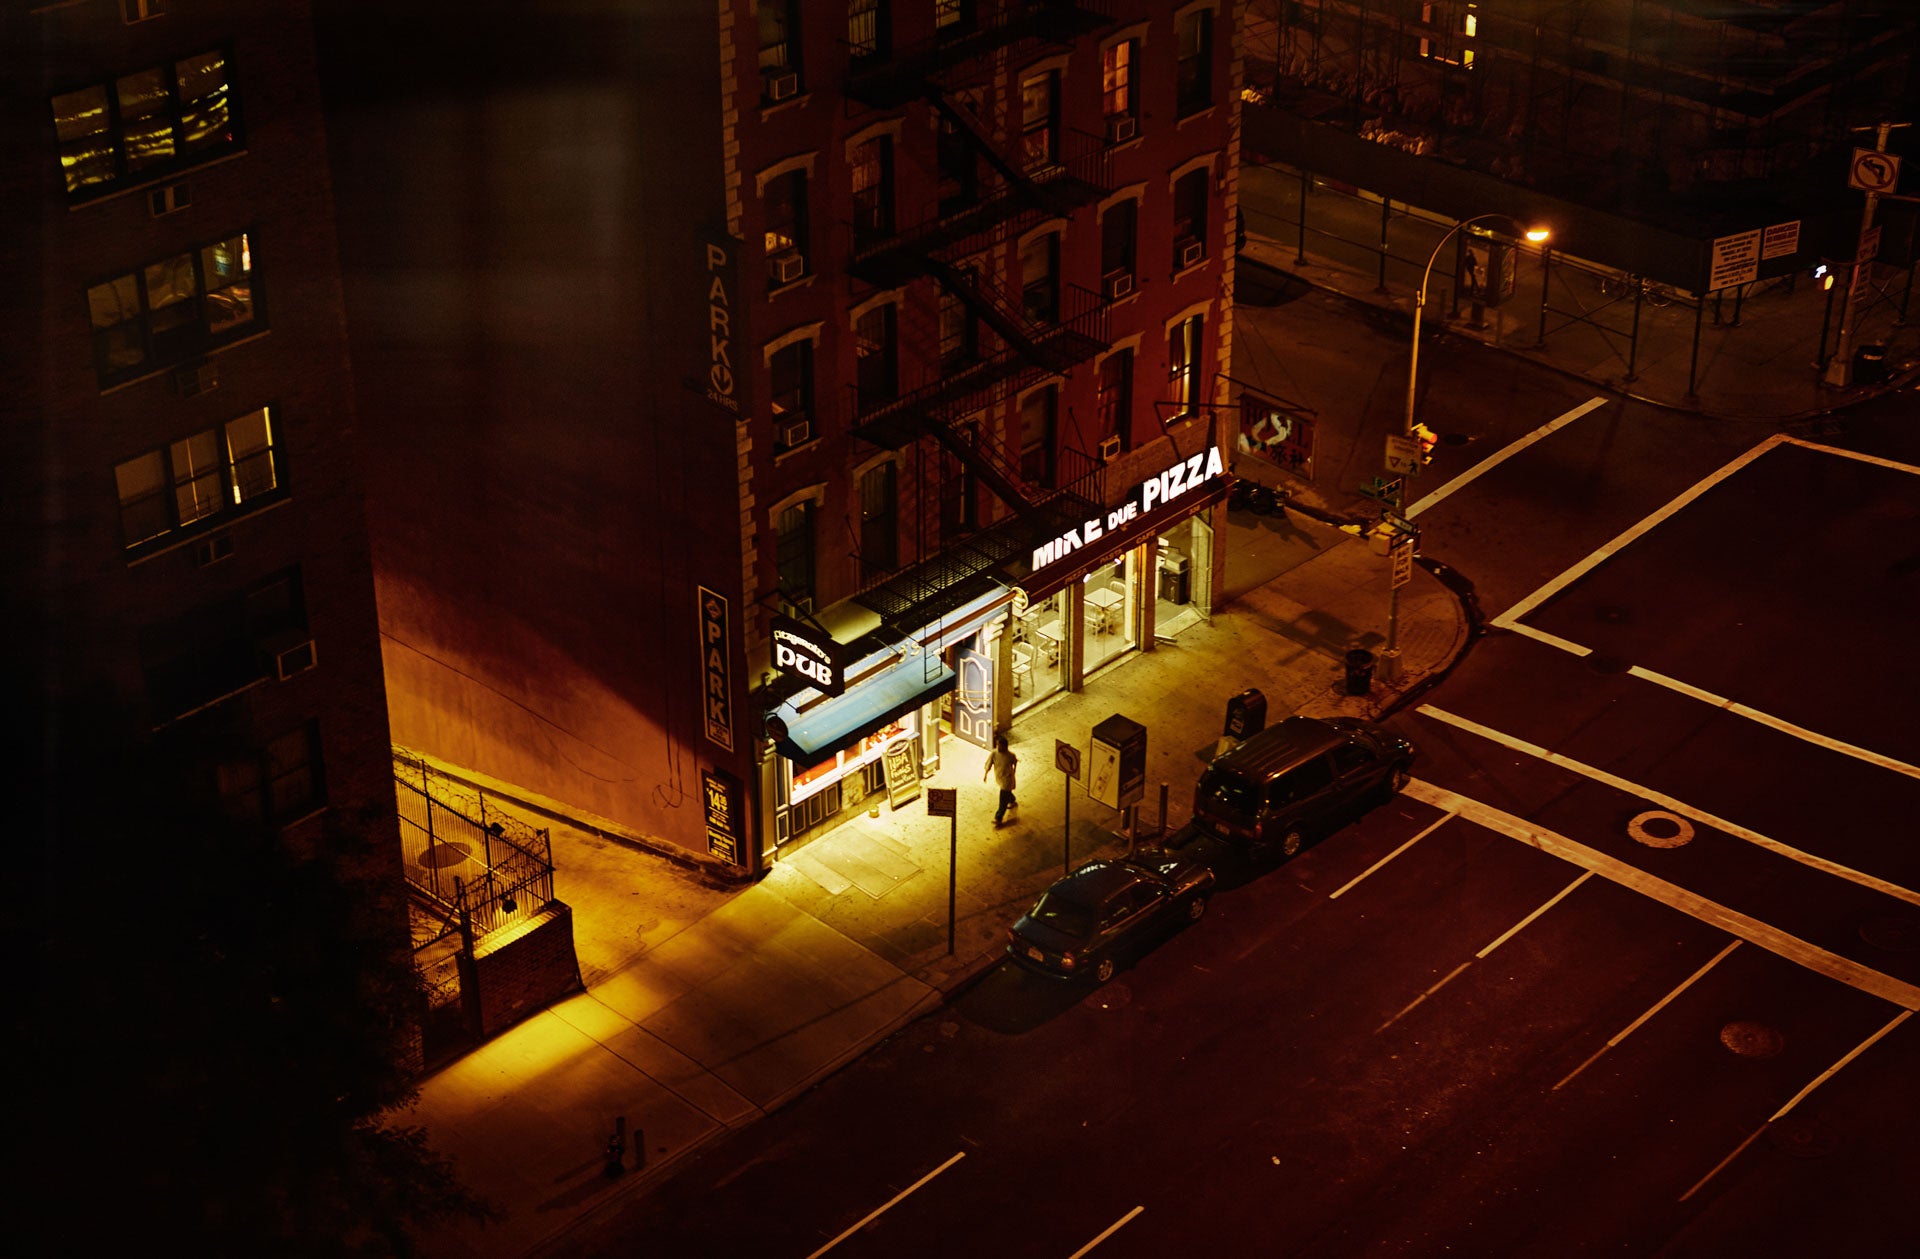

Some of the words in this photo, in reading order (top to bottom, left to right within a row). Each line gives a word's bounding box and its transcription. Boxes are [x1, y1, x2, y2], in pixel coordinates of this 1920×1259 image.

[706, 242, 730, 369] PARK
[1108, 500, 1138, 531] DUE
[1142, 445, 1224, 513] PIZZA
[707, 620, 726, 725] PARK
